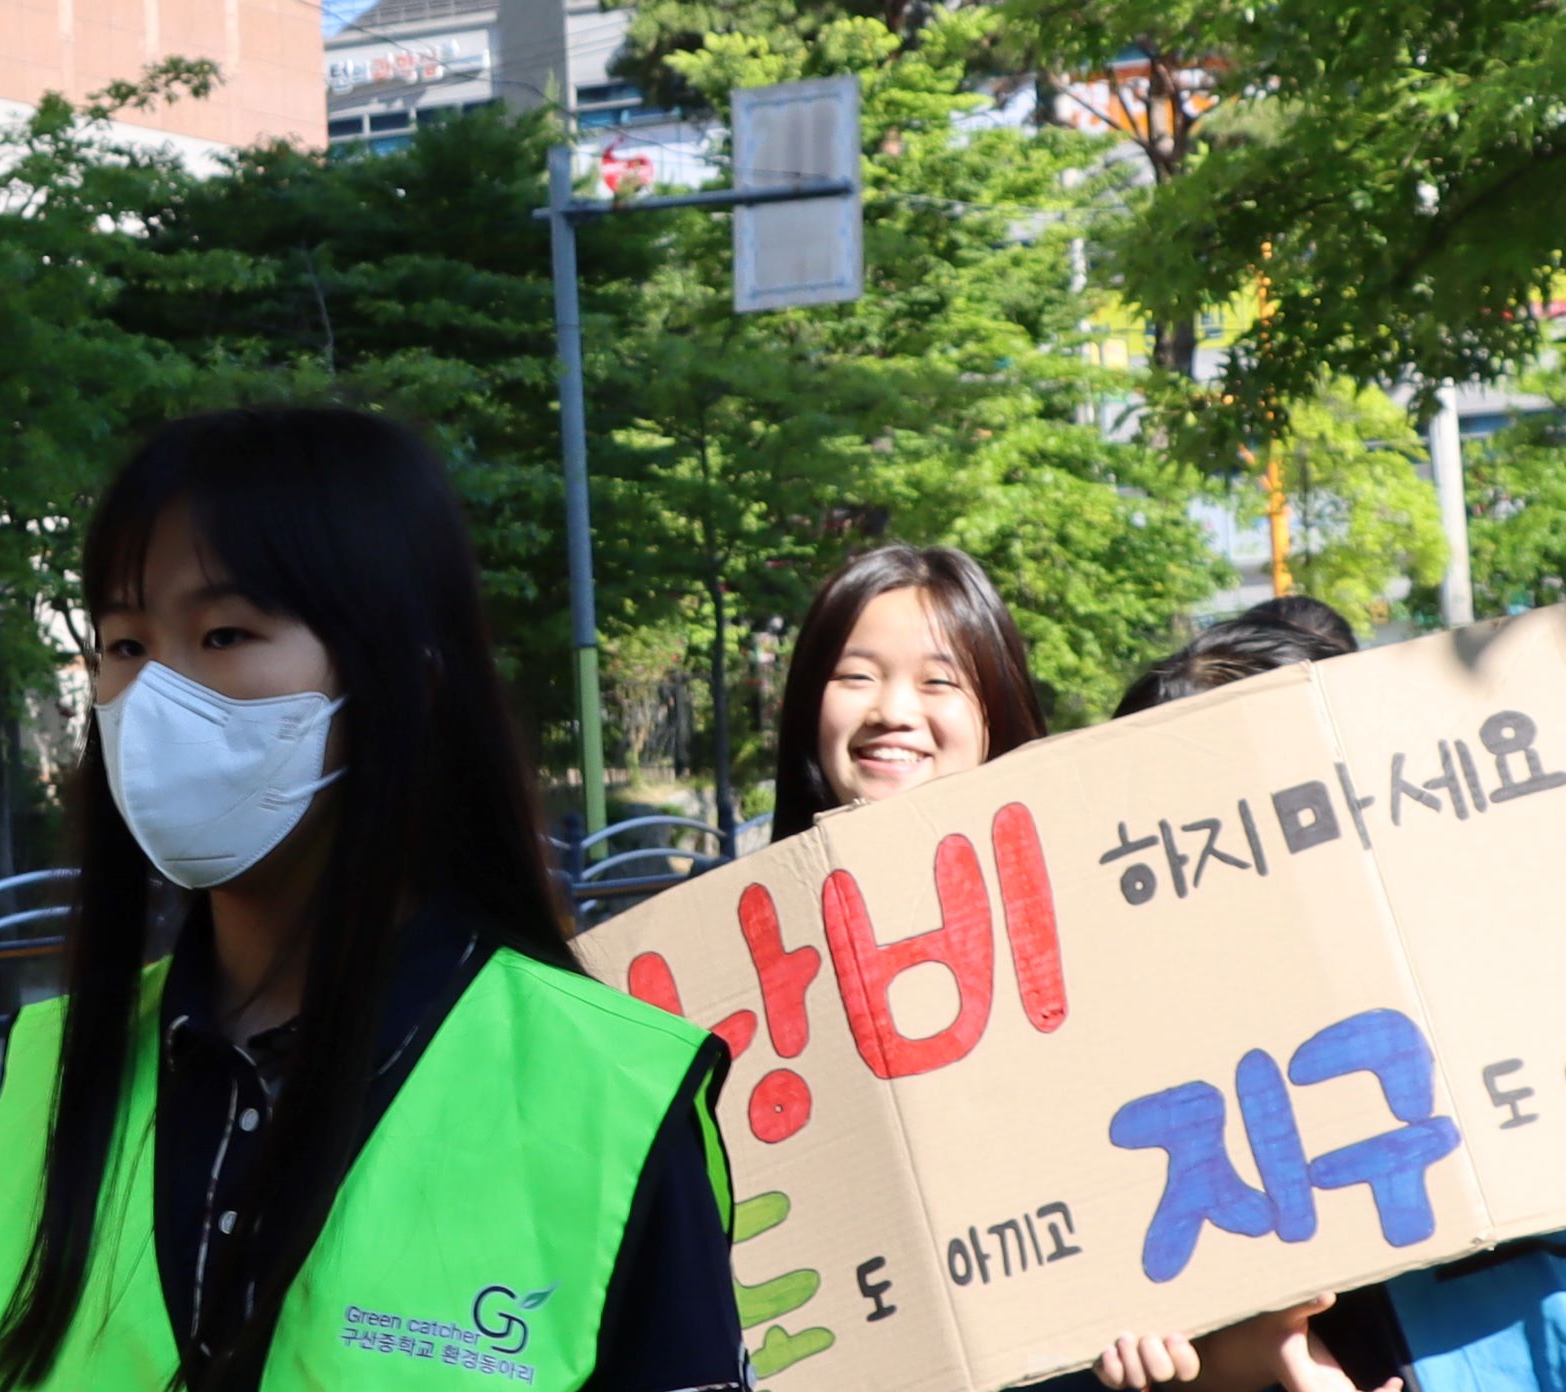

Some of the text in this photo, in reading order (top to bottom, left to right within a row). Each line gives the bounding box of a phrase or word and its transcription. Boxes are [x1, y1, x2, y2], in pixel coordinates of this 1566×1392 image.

[627, 802, 1068, 1144] 낭비
[947, 1200, 1081, 1286] 아끼고
[340, 1326, 435, 1360] 구산중학교
[344, 1304, 482, 1346] Green catcher
